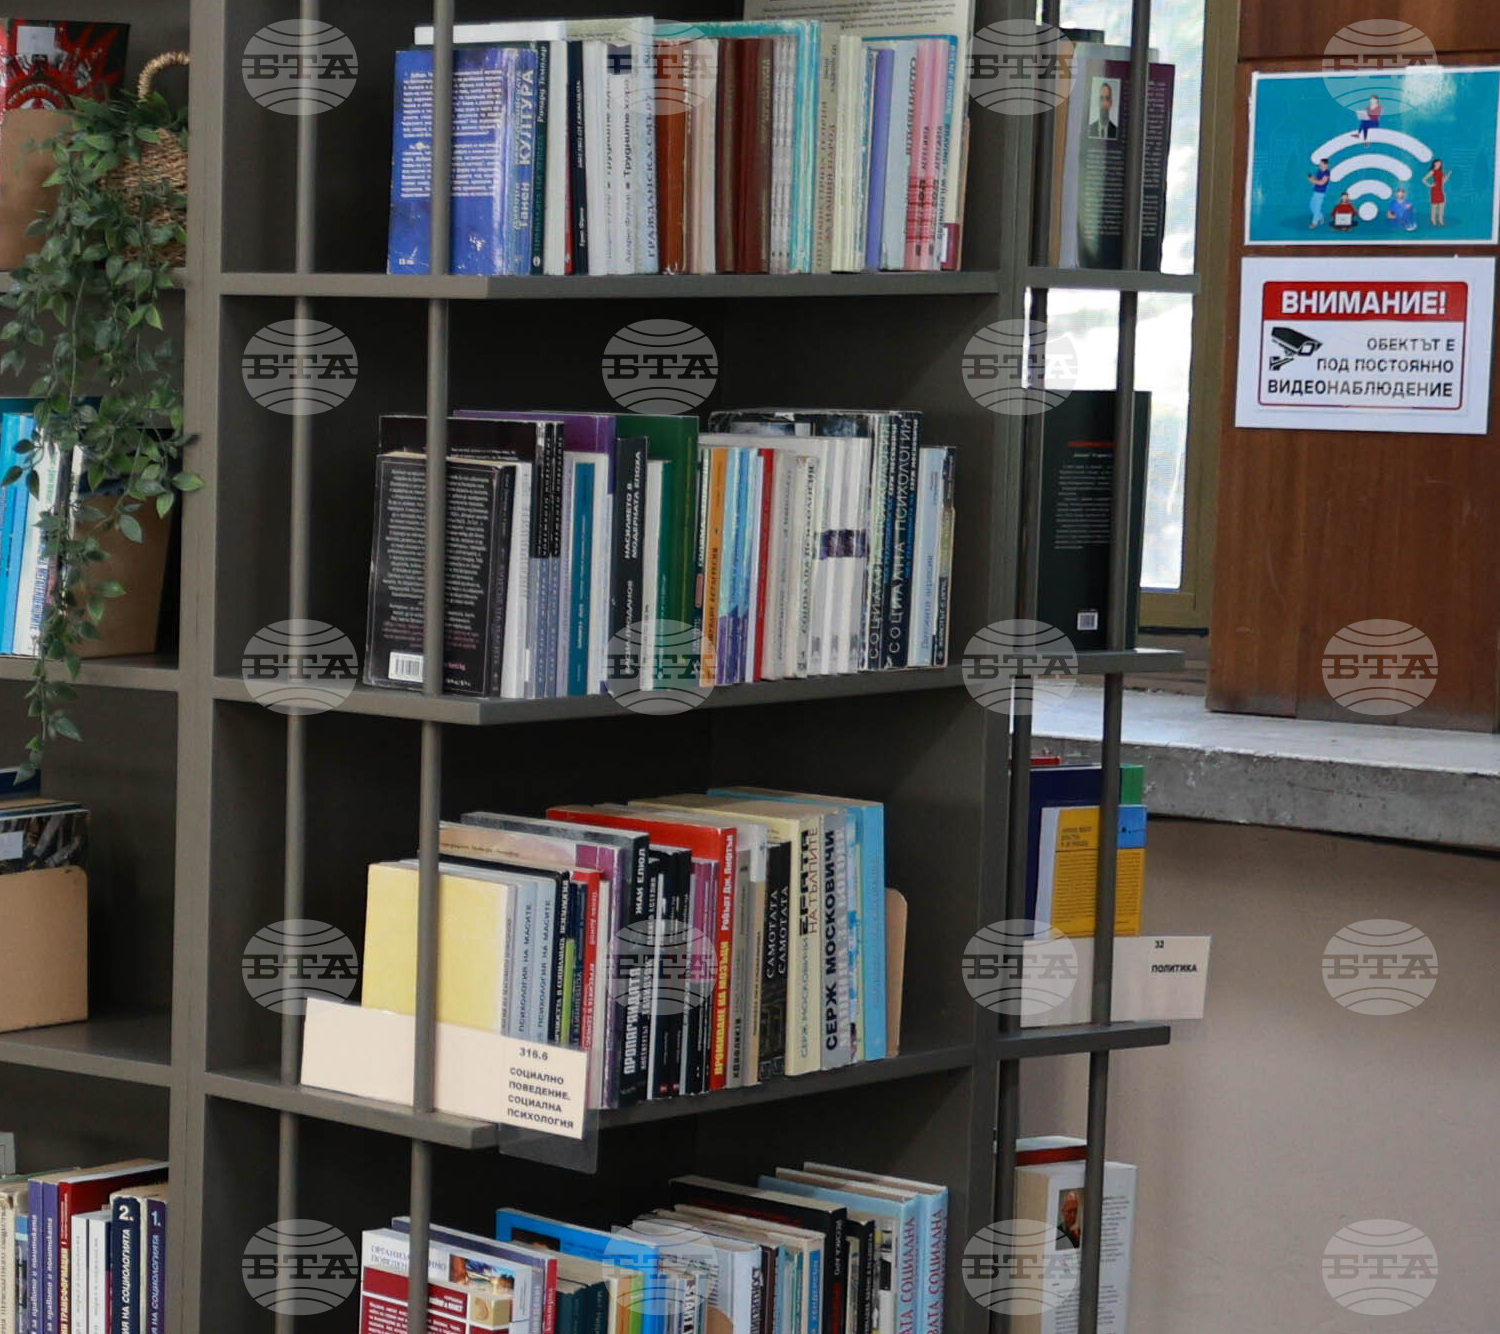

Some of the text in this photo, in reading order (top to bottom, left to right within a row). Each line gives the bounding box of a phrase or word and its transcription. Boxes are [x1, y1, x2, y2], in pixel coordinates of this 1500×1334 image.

[519, 69, 535, 166] КУЛТУРА
[1282, 290, 1447, 316] ВНИМАНИЕ!
[1366, 338, 1455, 352] ОБЕКТЪТ Е
[1316, 357, 1454, 375] ПОД ПОСТОЯННО
[1267, 379, 1453, 398] ВИДЕОНАБЛЮДЕНИЕ
[765, 889, 779, 979] САМОТАТА
[823, 830, 839, 1050] СЕРЖ МОСКОВИЧИ
[1154, 940, 1165, 950] 32
[1151, 963, 1198, 974] ПОЛИТИКА
[519, 1047, 549, 1061] 316.6
[509, 1067, 564, 1085] СОЦИАЛНО
[509, 1081, 572, 1101] ПОВЕДЕНИЕ.
[508, 1094, 562, 1112] СОЦИАЛНА
[507, 1108, 575, 1129] ПСИХОЛОГИЯ
[122, 1228, 131, 1304] СОЦИОЛОГИЯТА
[899, 1217, 917, 1304] СОЦИАЛНА
[150, 1235, 160, 1310] СОЦИОЛОГИЯТА
[122, 1305, 130, 1319] НА
[680, 1283, 697, 1329] START
[150, 1311, 158, 1325] НА
